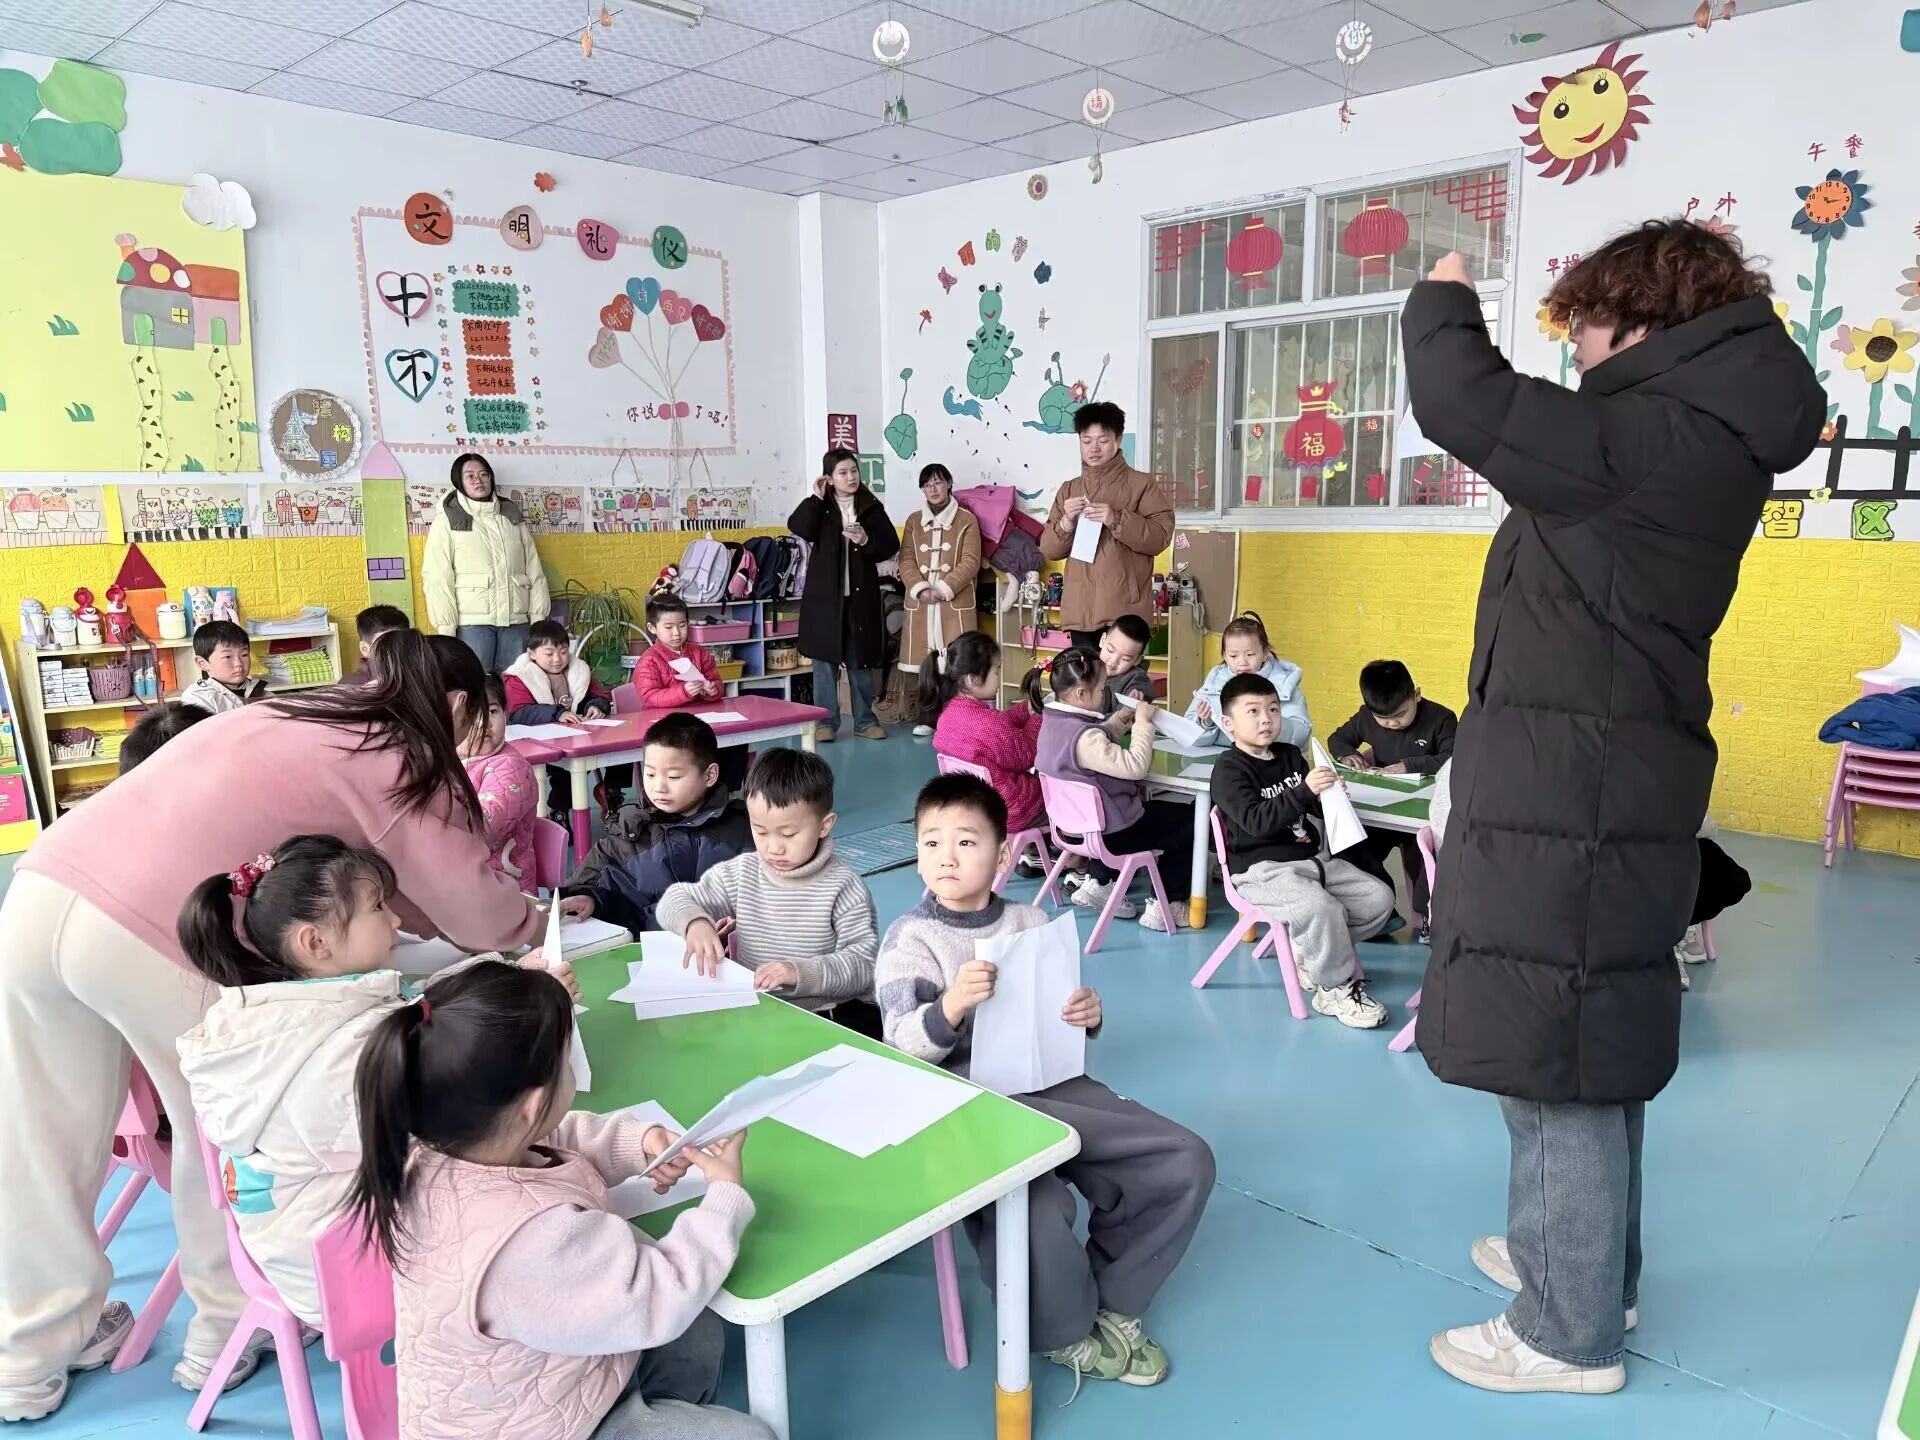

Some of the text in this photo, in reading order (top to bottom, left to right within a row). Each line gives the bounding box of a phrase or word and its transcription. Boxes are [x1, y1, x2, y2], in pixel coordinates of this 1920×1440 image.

[1682, 191, 1738, 222] 户外
[626, 402, 660, 423] 你说
[1365, 418, 1378, 431] 福
[830, 416, 856, 451] 美
[1300, 432, 1326, 457] 福
